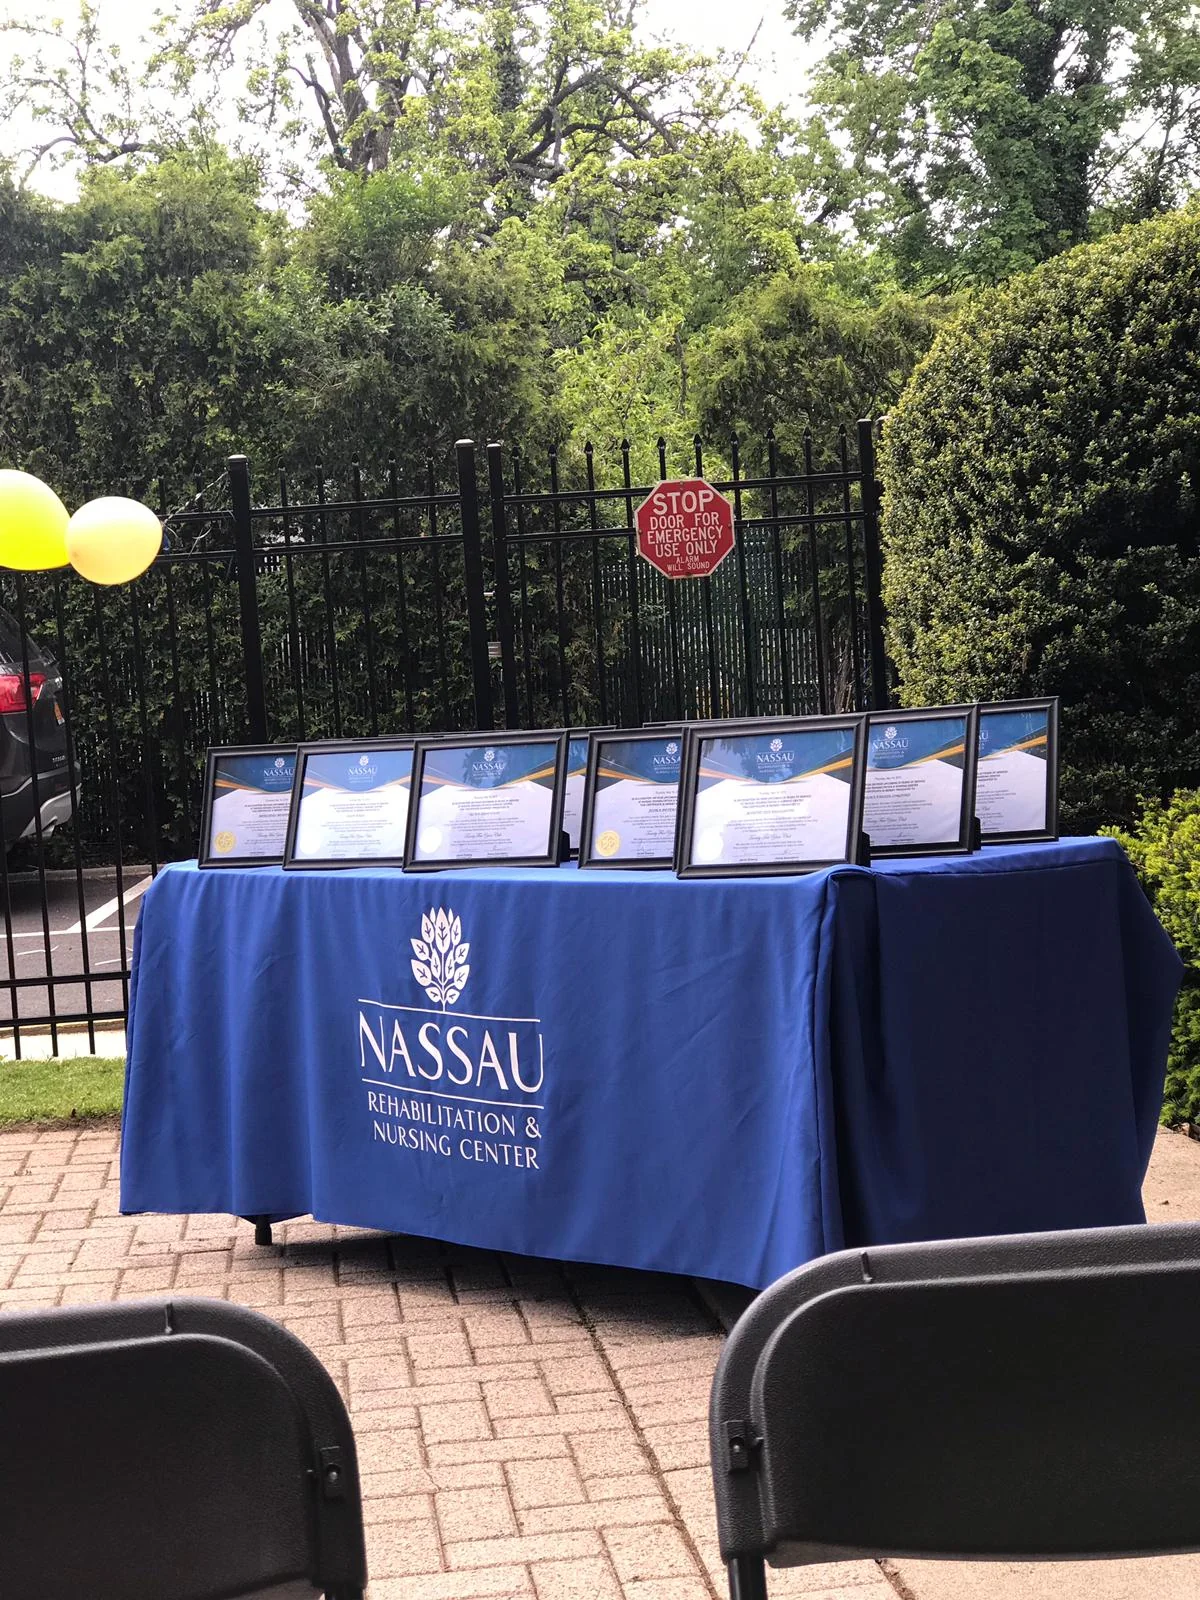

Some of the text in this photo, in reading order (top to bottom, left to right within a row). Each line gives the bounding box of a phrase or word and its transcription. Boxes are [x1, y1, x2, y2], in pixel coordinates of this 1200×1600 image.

[652, 489, 714, 516] STOP
[650, 511, 720, 530] DOOR FOR
[647, 525, 723, 545] EMERGENCY
[655, 539, 718, 558] USE ONLY
[666, 560, 710, 572] WILL SOUND
[675, 555, 700, 564] ALARM
[871, 739, 909, 750] NASSAU
[472, 762, 505, 771] NASSAU
[756, 752, 795, 763] NASSAU
[348, 766, 378, 776] NASSAU
[359, 1010, 544, 1093] NASSAU
[367, 1091, 542, 1139] REHABILITATION &
[373, 1120, 540, 1170] NURSING CENTER
